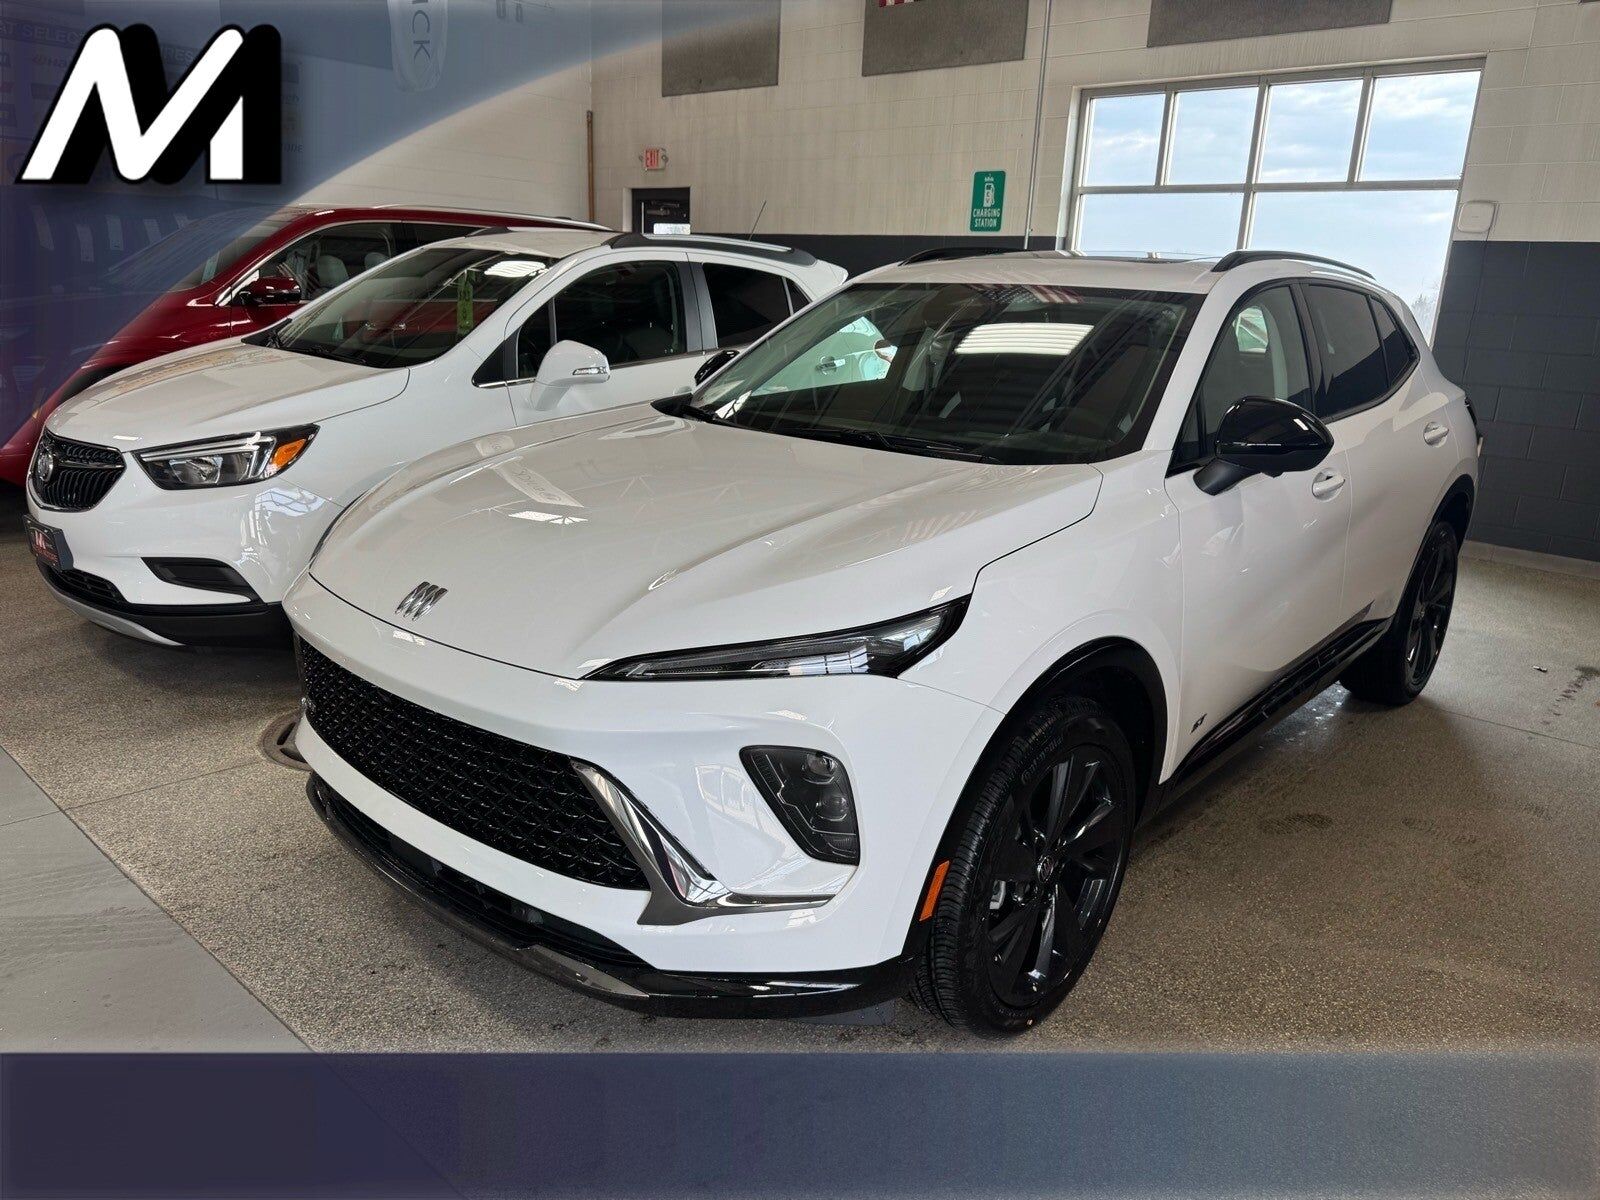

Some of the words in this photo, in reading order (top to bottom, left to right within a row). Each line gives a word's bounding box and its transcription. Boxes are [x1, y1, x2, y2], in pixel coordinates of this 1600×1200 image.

[645, 149, 660, 168] EXIT
[973, 208, 1000, 218] CHARGING
[974, 218, 998, 228] STATION
